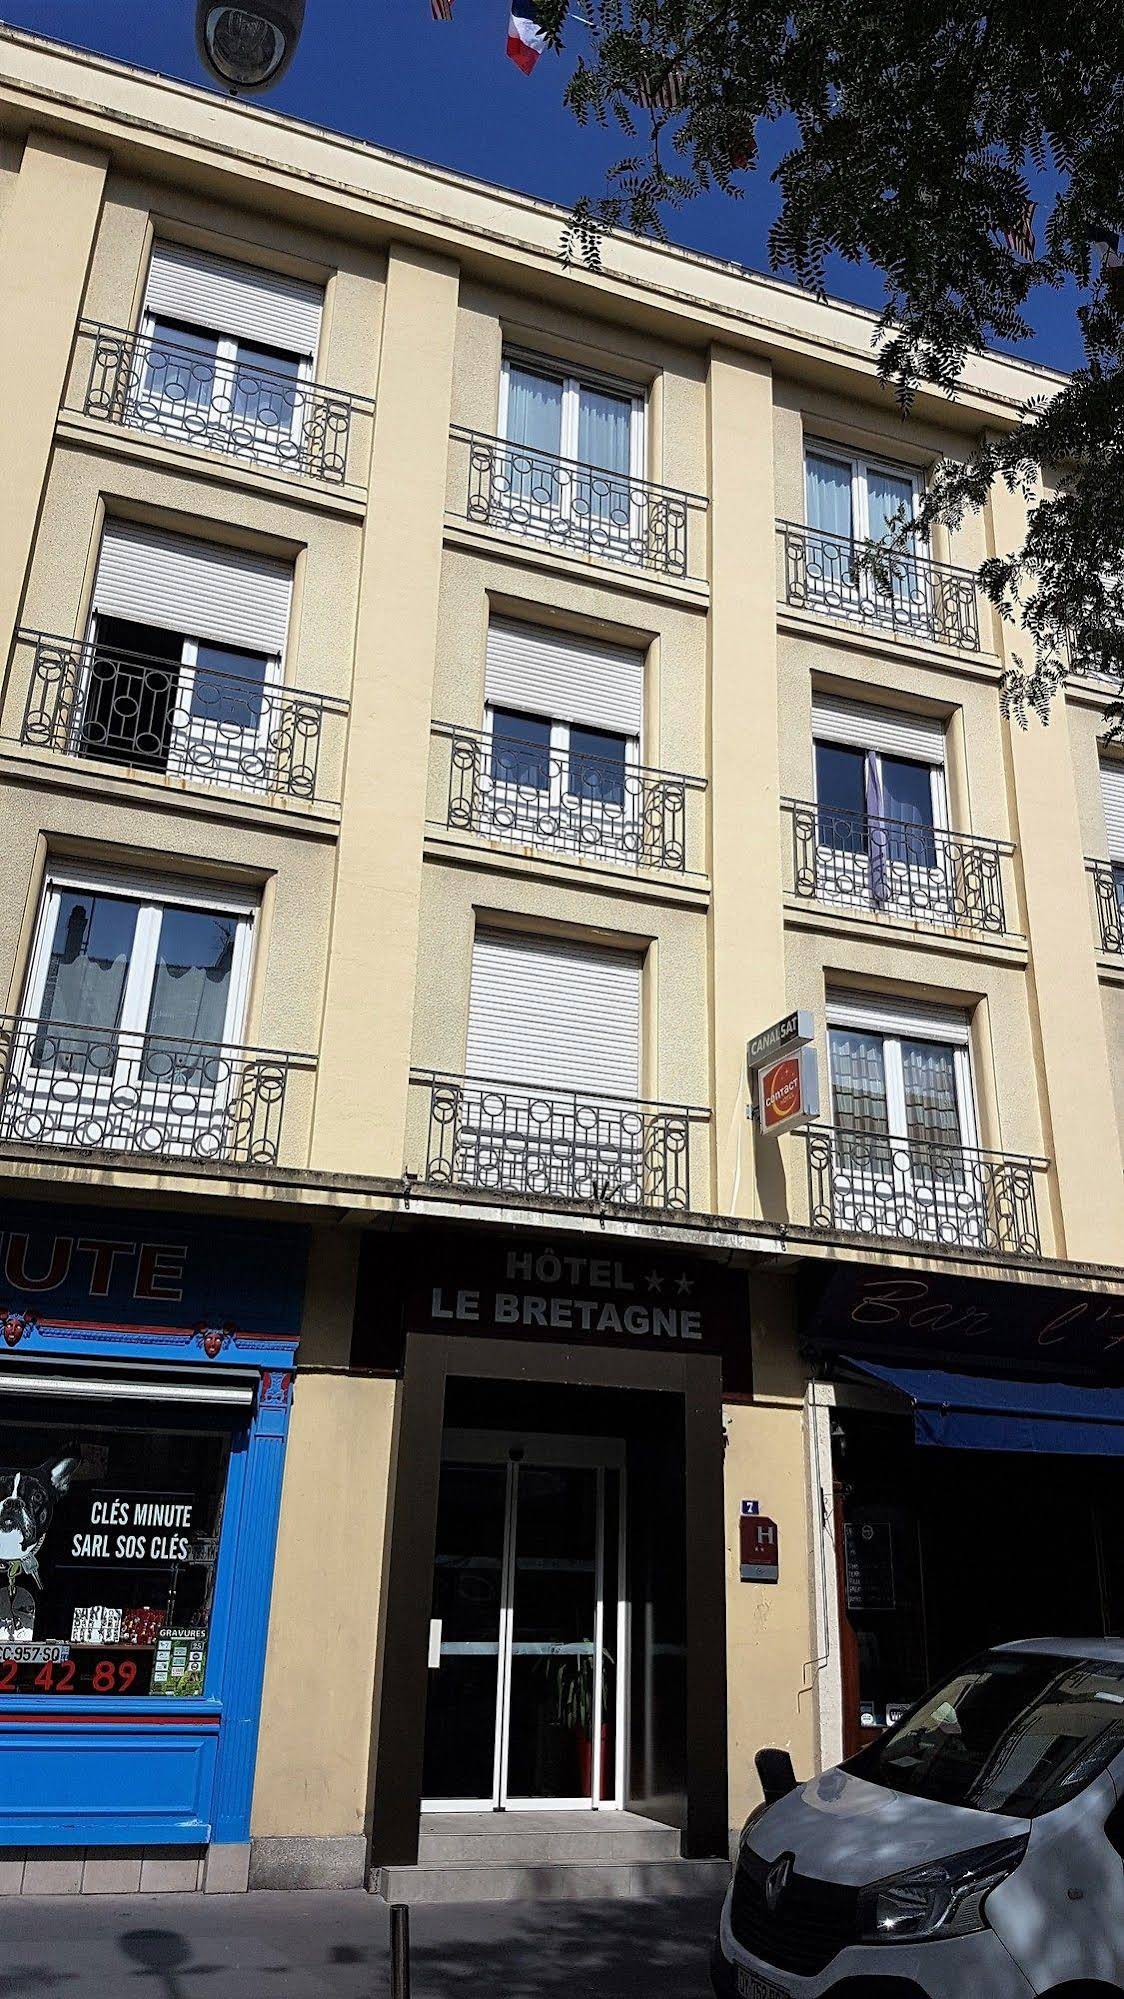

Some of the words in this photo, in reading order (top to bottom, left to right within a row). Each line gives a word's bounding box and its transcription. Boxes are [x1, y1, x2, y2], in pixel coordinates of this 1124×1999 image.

[751, 1016, 798, 1055] CANALSAT
[0, 1231, 189, 1302] UTE
[506, 1247, 635, 1291] HÔTEL
[431, 1287, 481, 1321] LE
[494, 1292, 704, 1340] BRETAGNE
[851, 1280, 993, 1337] Bar
[90, 1498, 130, 1526] CLÉS
[133, 1502, 193, 1528] MINUTE
[746, 1502, 754, 1514] 7
[71, 1533, 110, 1558] SARL
[115, 1534, 146, 1560] SOS
[150, 1533, 189, 1561] CLÉS
[757, 1526, 775, 1545] H
[159, 1628, 206, 1639] GRAVURES
[34, 1660, 76, 1692] 42
[92, 1660, 137, 1692] 89
